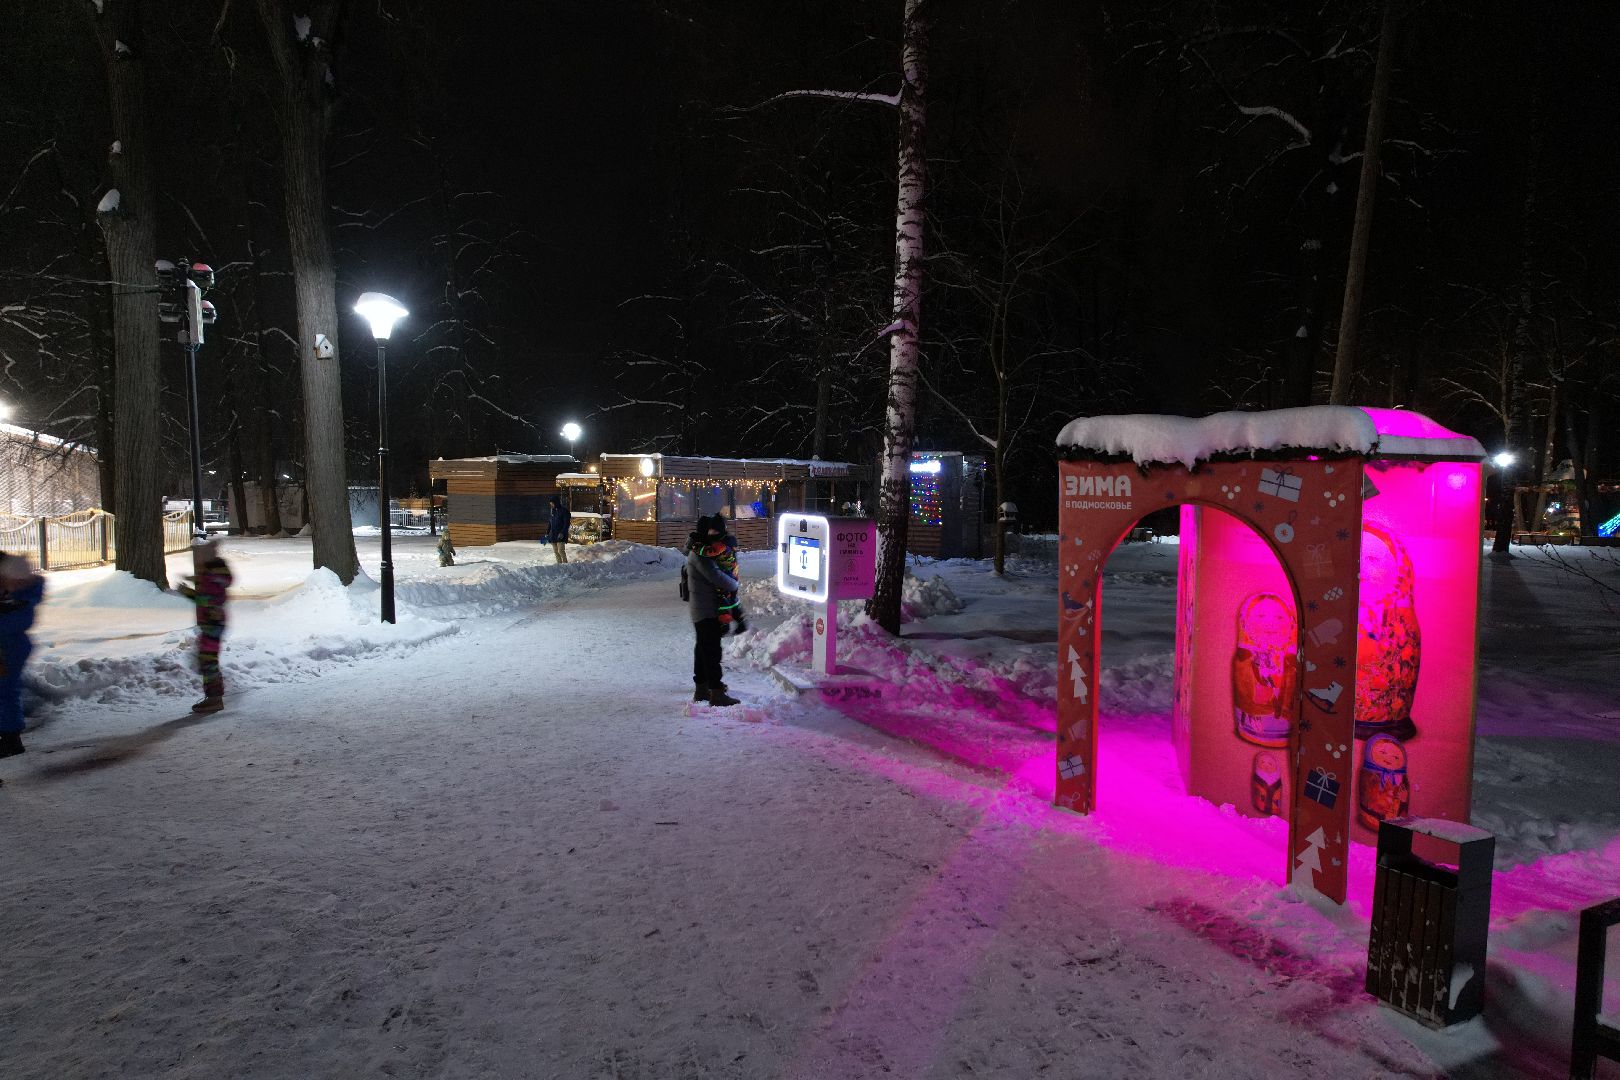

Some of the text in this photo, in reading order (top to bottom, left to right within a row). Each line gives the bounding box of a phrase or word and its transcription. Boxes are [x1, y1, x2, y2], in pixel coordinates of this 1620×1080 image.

[1065, 475, 1132, 497] ЗИМА
[1072, 501, 1132, 510] ПОДМОСКОВЬЕ
[836, 532, 868, 542] ФОТО
